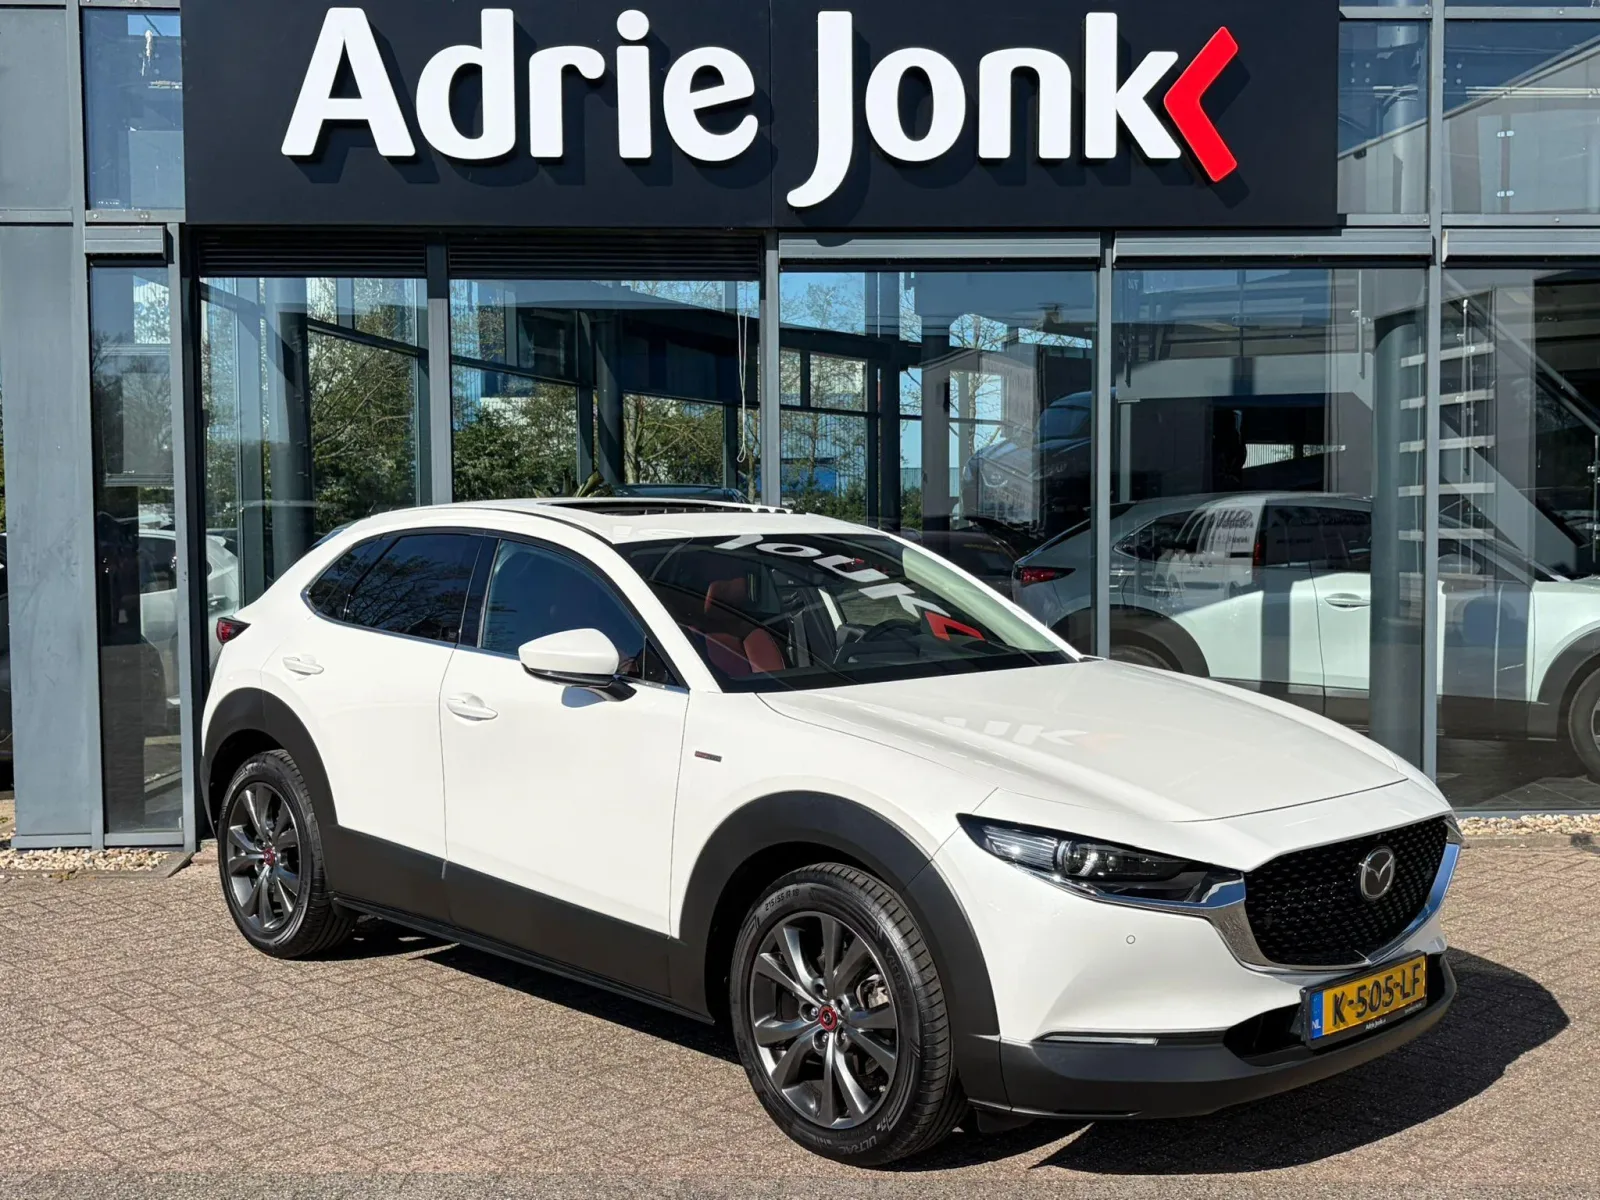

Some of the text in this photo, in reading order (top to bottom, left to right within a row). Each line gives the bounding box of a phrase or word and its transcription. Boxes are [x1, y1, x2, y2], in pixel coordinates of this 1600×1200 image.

[281, 7, 1182, 208] Adrie Jonk
[1332, 963, 1421, 1027] K-505-LF
[1312, 1018, 1321, 1029] NL
[838, 1135, 877, 1155] ULTRAC
